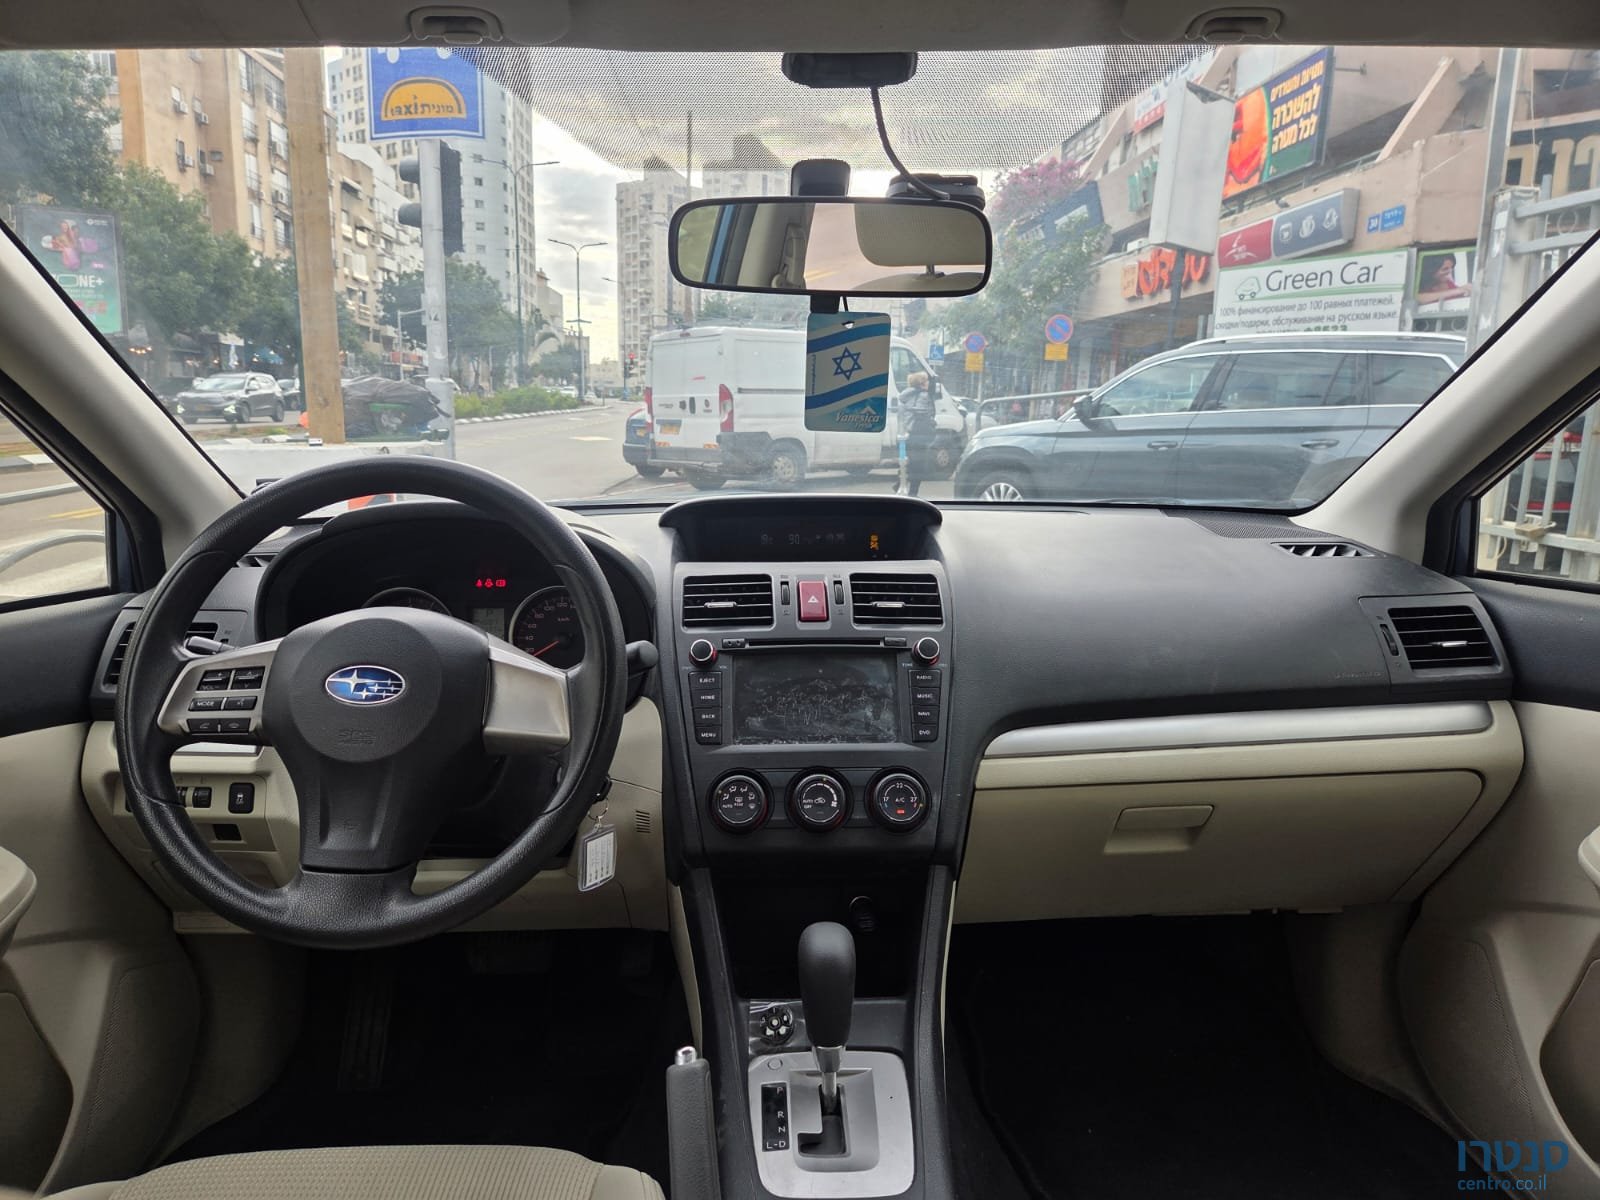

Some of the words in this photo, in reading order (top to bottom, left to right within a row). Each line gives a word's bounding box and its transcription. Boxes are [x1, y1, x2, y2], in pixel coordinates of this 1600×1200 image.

[391, 95, 418, 116] taxi
[420, 103, 454, 115] מונית
[1272, 82, 1321, 131] להשכרה
[1271, 123, 1298, 154] מטרה
[1299, 113, 1318, 141] לכל
[1265, 269, 1333, 292] Green
[1340, 261, 1383, 285] Car
[777, 1110, 785, 1119] R
